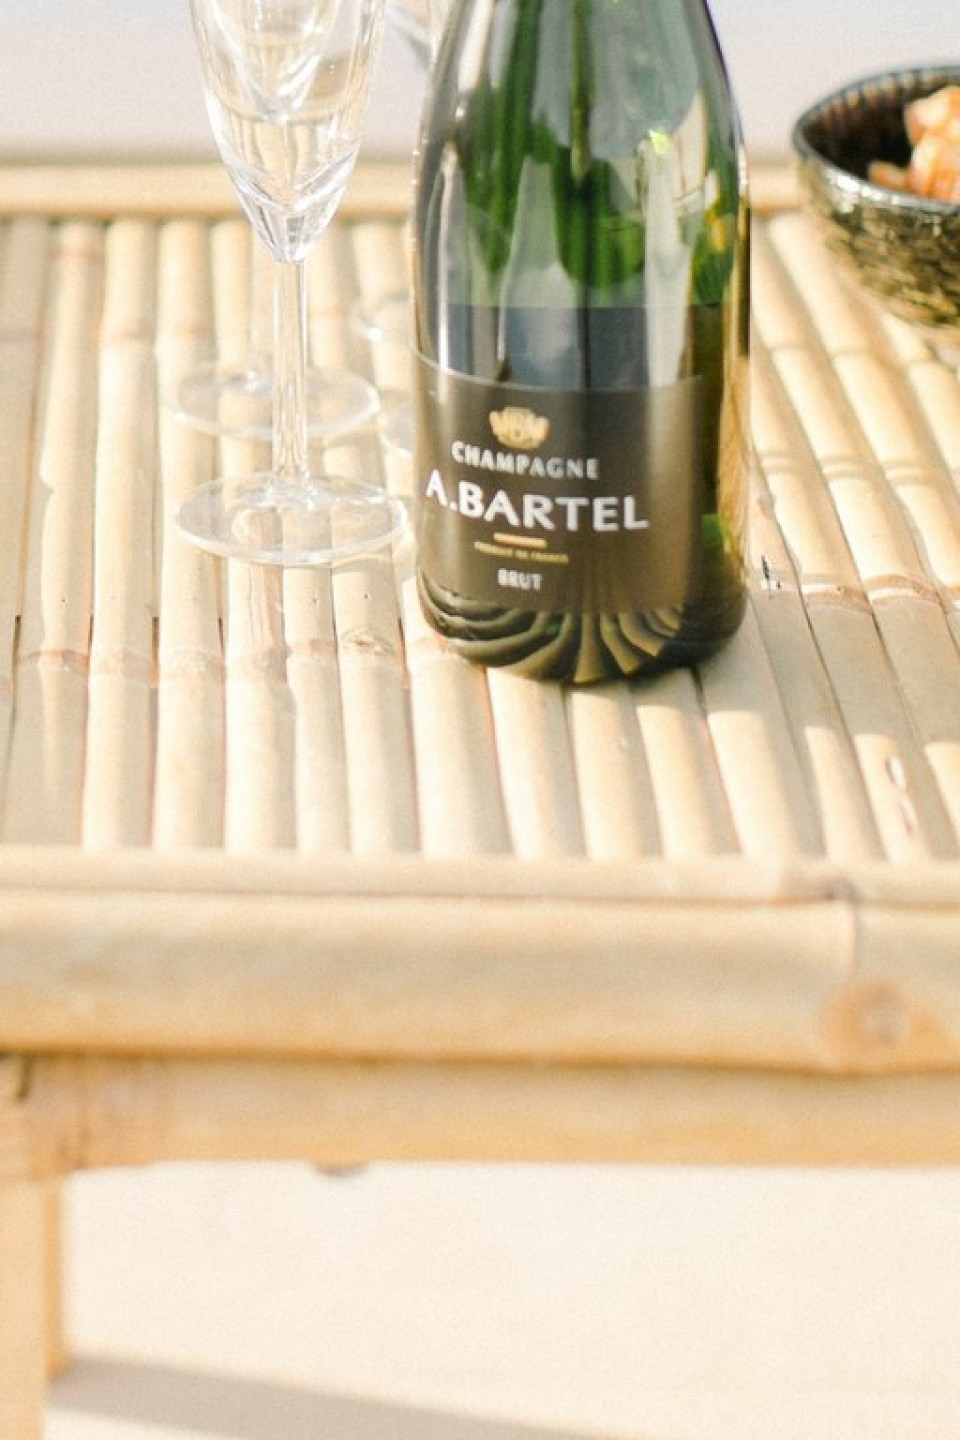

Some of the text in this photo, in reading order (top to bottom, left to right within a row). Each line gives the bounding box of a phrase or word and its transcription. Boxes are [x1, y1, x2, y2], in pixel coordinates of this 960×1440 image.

[451, 441, 598, 479] CHAMPAGNE
[426, 469, 649, 531] A.BARTEL
[498, 568, 542, 590] BRUT
